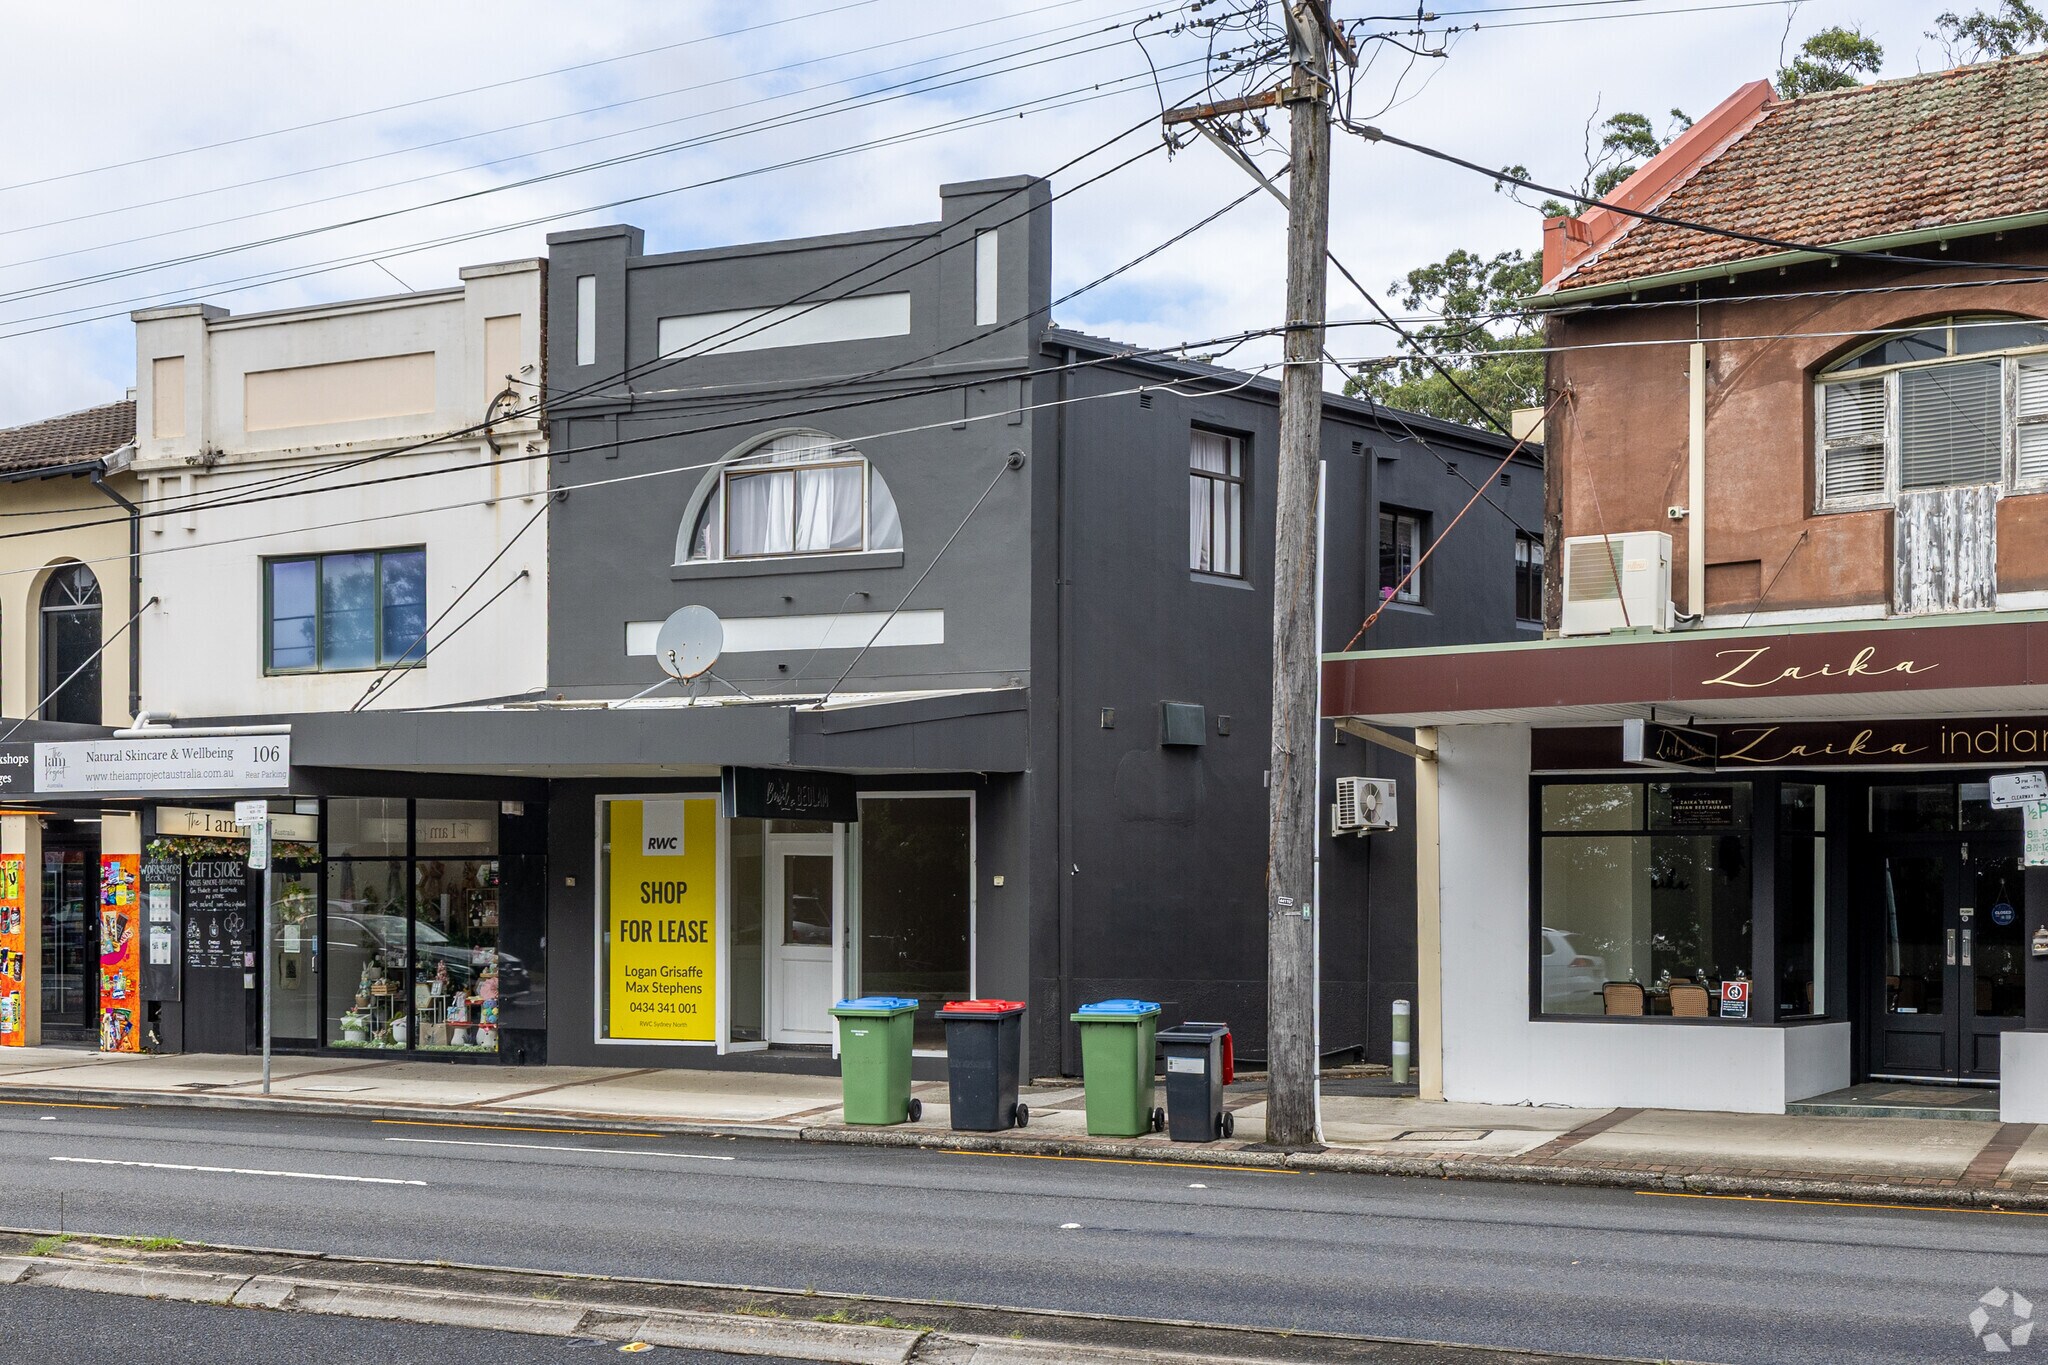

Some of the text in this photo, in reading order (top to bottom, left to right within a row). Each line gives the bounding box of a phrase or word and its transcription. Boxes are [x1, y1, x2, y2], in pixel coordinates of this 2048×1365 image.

[1701, 646, 1939, 688] Zaika
[1719, 727, 1929, 763] Zaika
[86, 747, 234, 762] Natural Skincare & Wellbeing
[253, 745, 280, 763] 106
[85, 769, 234, 783] www.theiamprojectaustralia.com.au
[245, 770, 287, 780] Rear Parking
[184, 810, 202, 831] The
[215, 819, 239, 834] am
[647, 837, 678, 850] RWC
[140, 863, 182, 875] WORKSHOPS
[189, 861, 244, 878] GIFT STORE
[640, 881, 688, 904] SHOP
[620, 919, 708, 943] FOR LEASE
[625, 965, 703, 980] Logan Grisaffe
[625, 981, 703, 996] Max Stephens
[629, 1002, 697, 1014] 0434 341 001
[653, 1021, 672, 1029] Sydney
